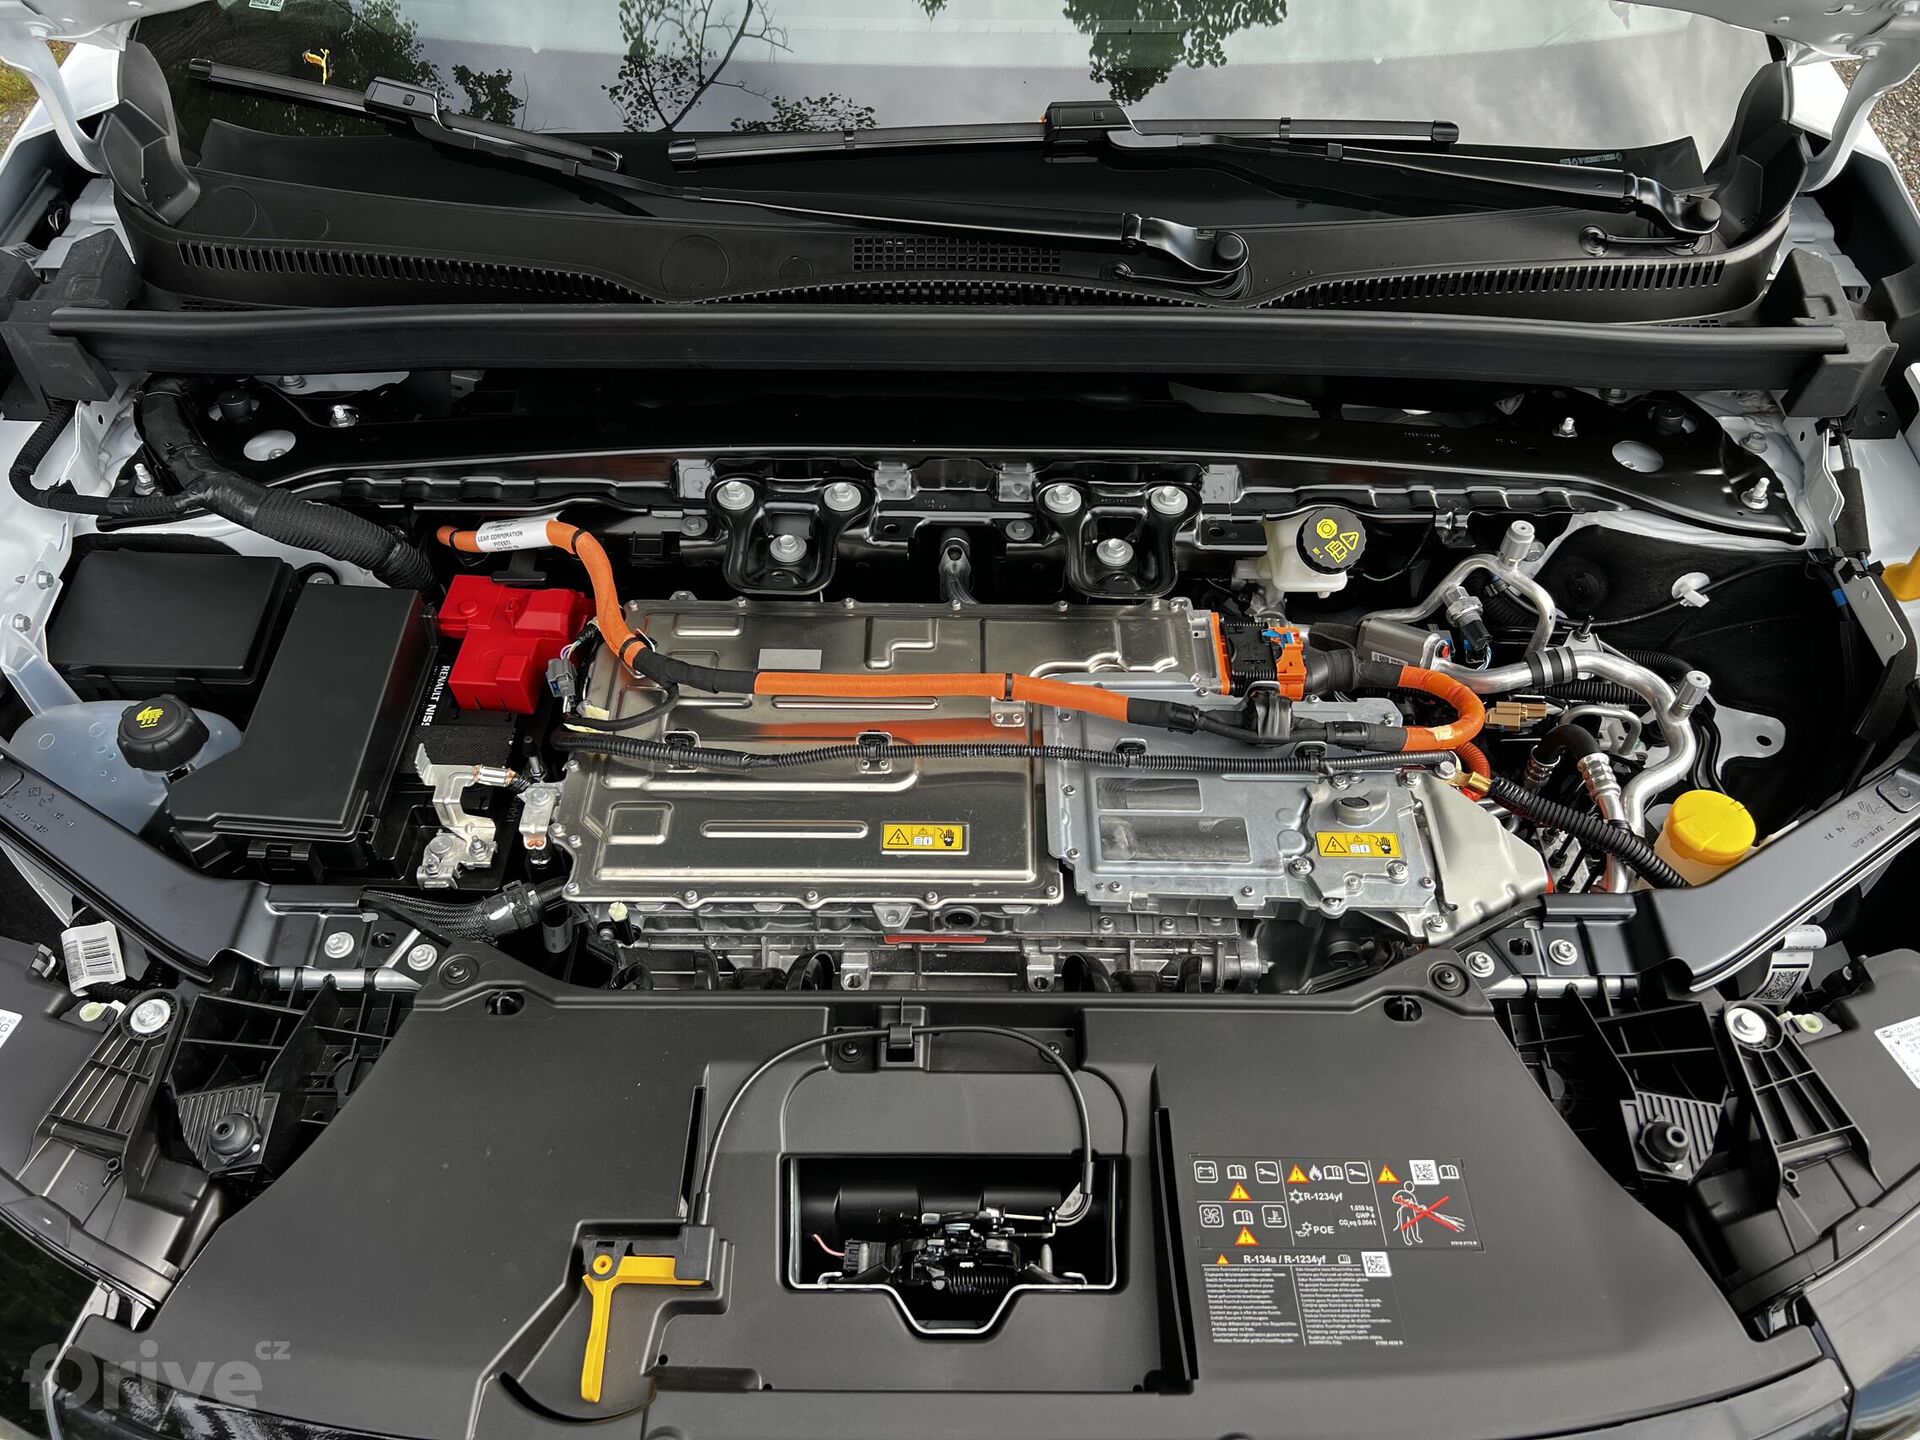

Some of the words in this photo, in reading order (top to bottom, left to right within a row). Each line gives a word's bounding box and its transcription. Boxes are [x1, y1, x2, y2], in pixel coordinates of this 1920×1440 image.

[490, 530, 523, 540] CORPORATION
[430, 665, 451, 702] RENAULT
[1303, 1192, 1343, 1203] R-1234yf
[1313, 1225, 1335, 1234] POE
[1243, 1254, 1277, 1264] R-134a
[1284, 1254, 1326, 1266] R-1234yf
